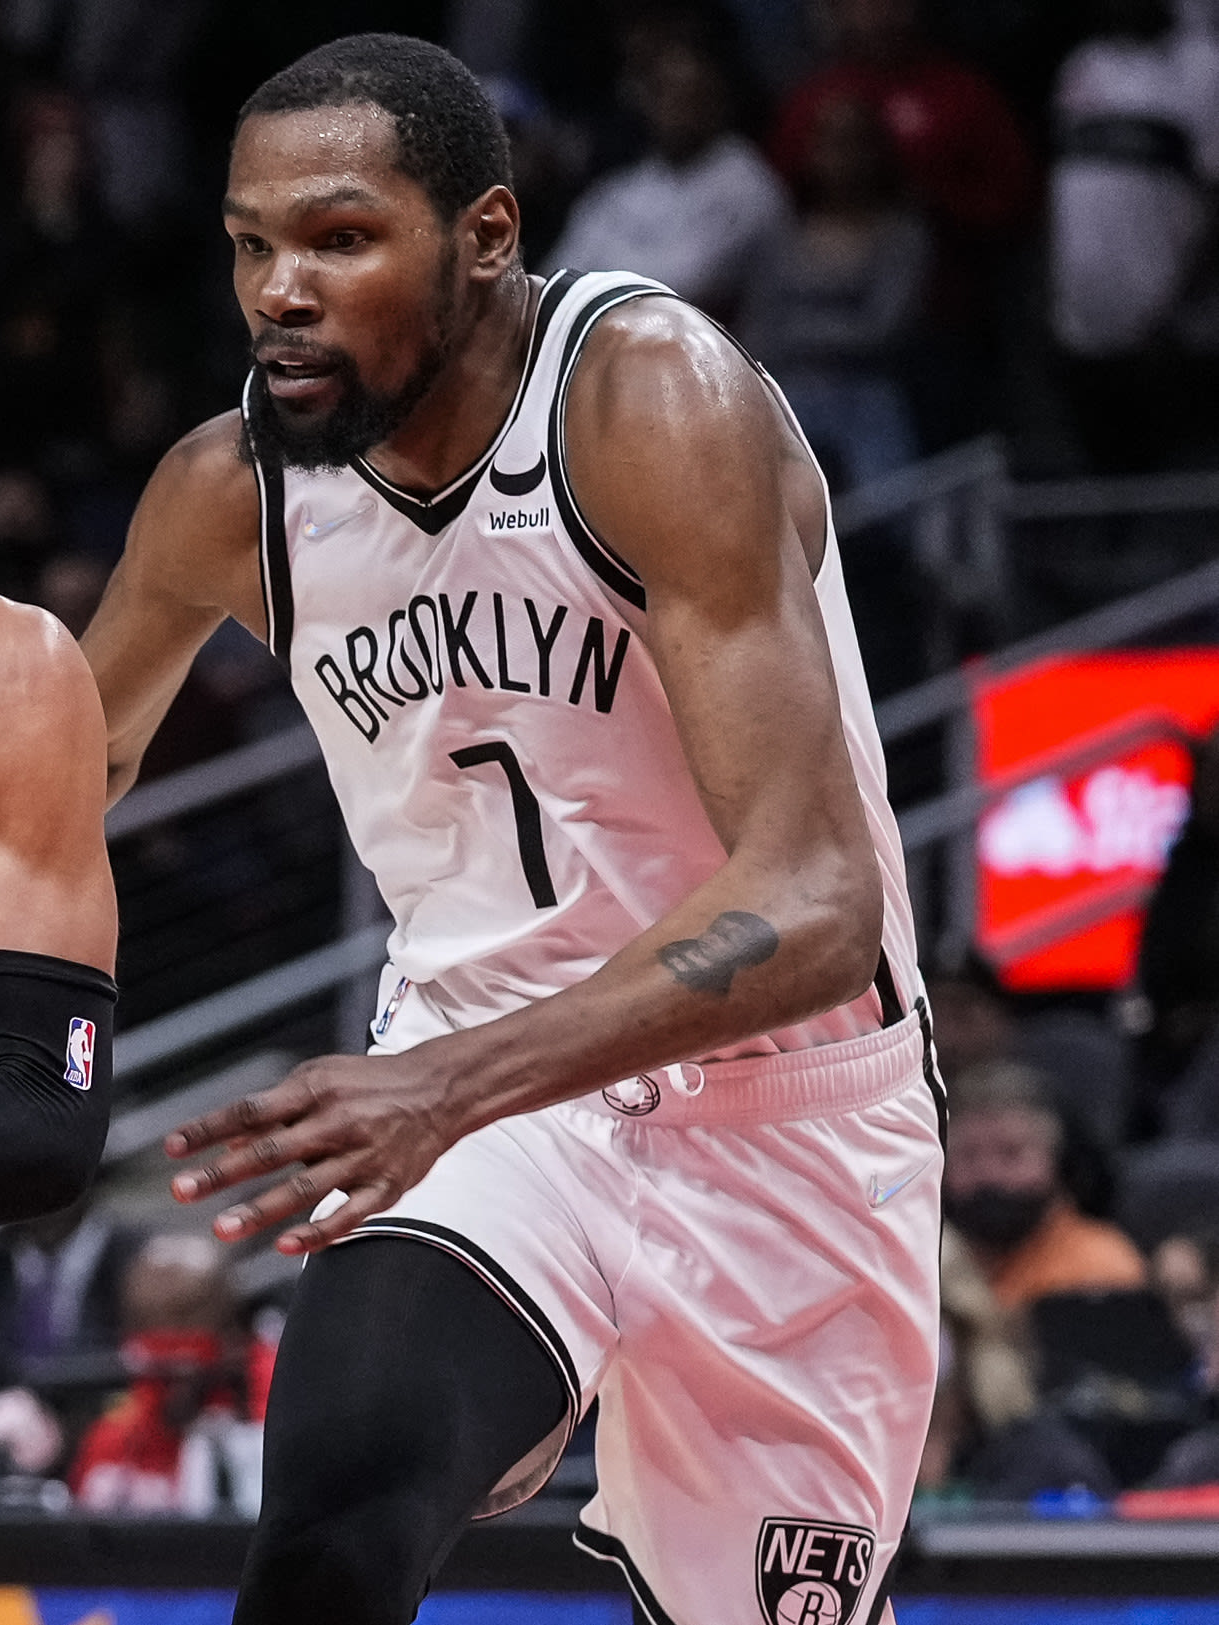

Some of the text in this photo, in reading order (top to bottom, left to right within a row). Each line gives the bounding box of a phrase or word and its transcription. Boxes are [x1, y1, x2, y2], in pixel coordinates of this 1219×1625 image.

[489, 508, 550, 531] Webull
[315, 591, 631, 744] BROOKLYN
[449, 741, 558, 909] 7
[763, 1527, 871, 1587] NETS
